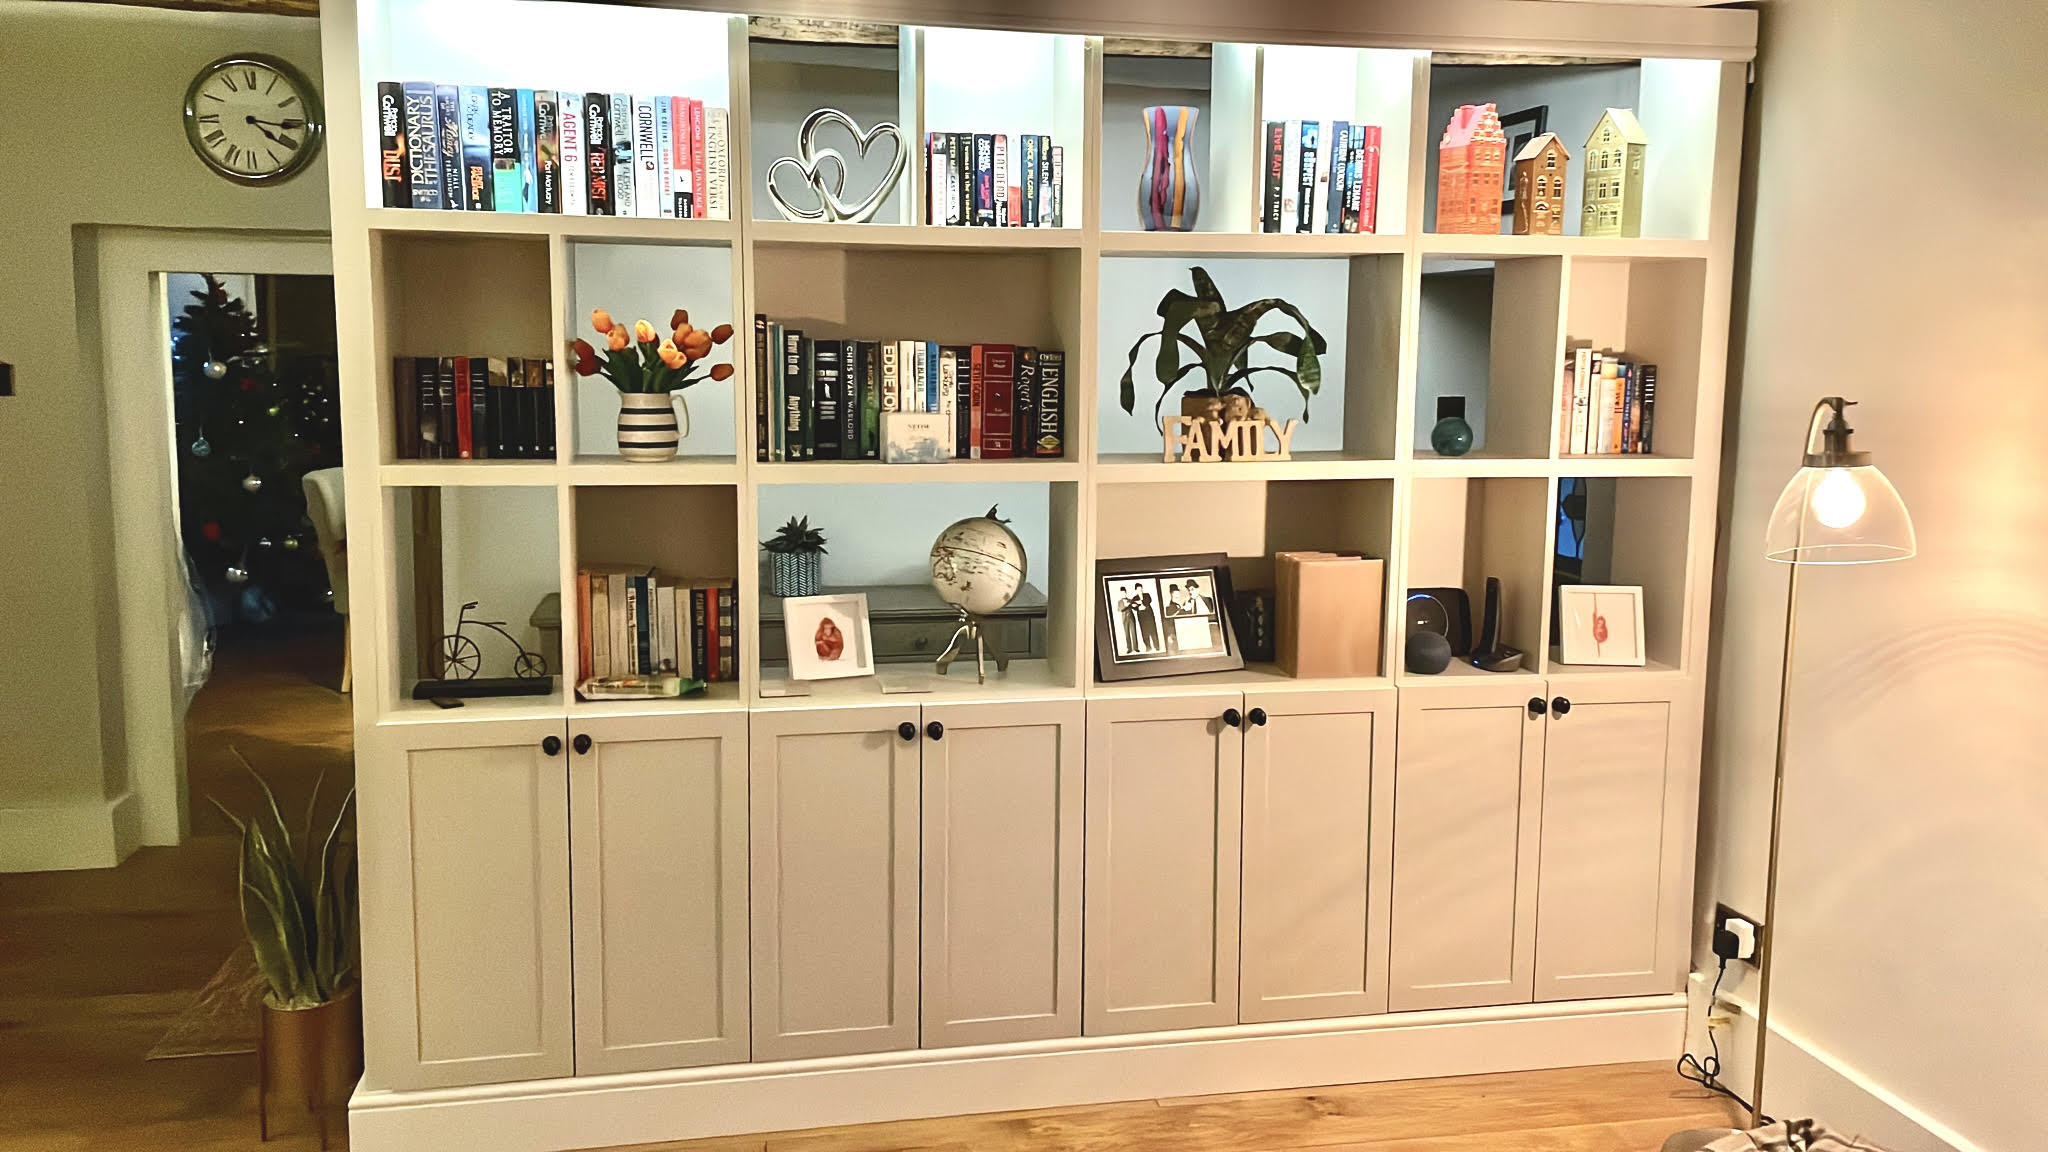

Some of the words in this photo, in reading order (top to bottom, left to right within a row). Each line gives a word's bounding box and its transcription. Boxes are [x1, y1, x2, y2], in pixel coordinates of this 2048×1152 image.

[491, 91, 501, 106] TO
[407, 96, 424, 184] DICTIONARY
[420, 96, 438, 184] THESAURUS
[492, 110, 504, 155] MEMORY
[501, 107, 513, 154] TRAITOR
[563, 113, 577, 150] AGENT
[638, 106, 654, 161] CORNWELL
[787, 335, 799, 353] How
[788, 355, 799, 363] to
[846, 346, 854, 372] CHRIS
[788, 365, 799, 374] do
[884, 345, 896, 387] EDDIE
[958, 359, 970, 402] HILL
[1017, 364, 1035, 411] Roget's
[787, 396, 801, 431] Anything
[1041, 368, 1059, 433] ENGLISH
[1162, 415, 1300, 463] FAMILY
